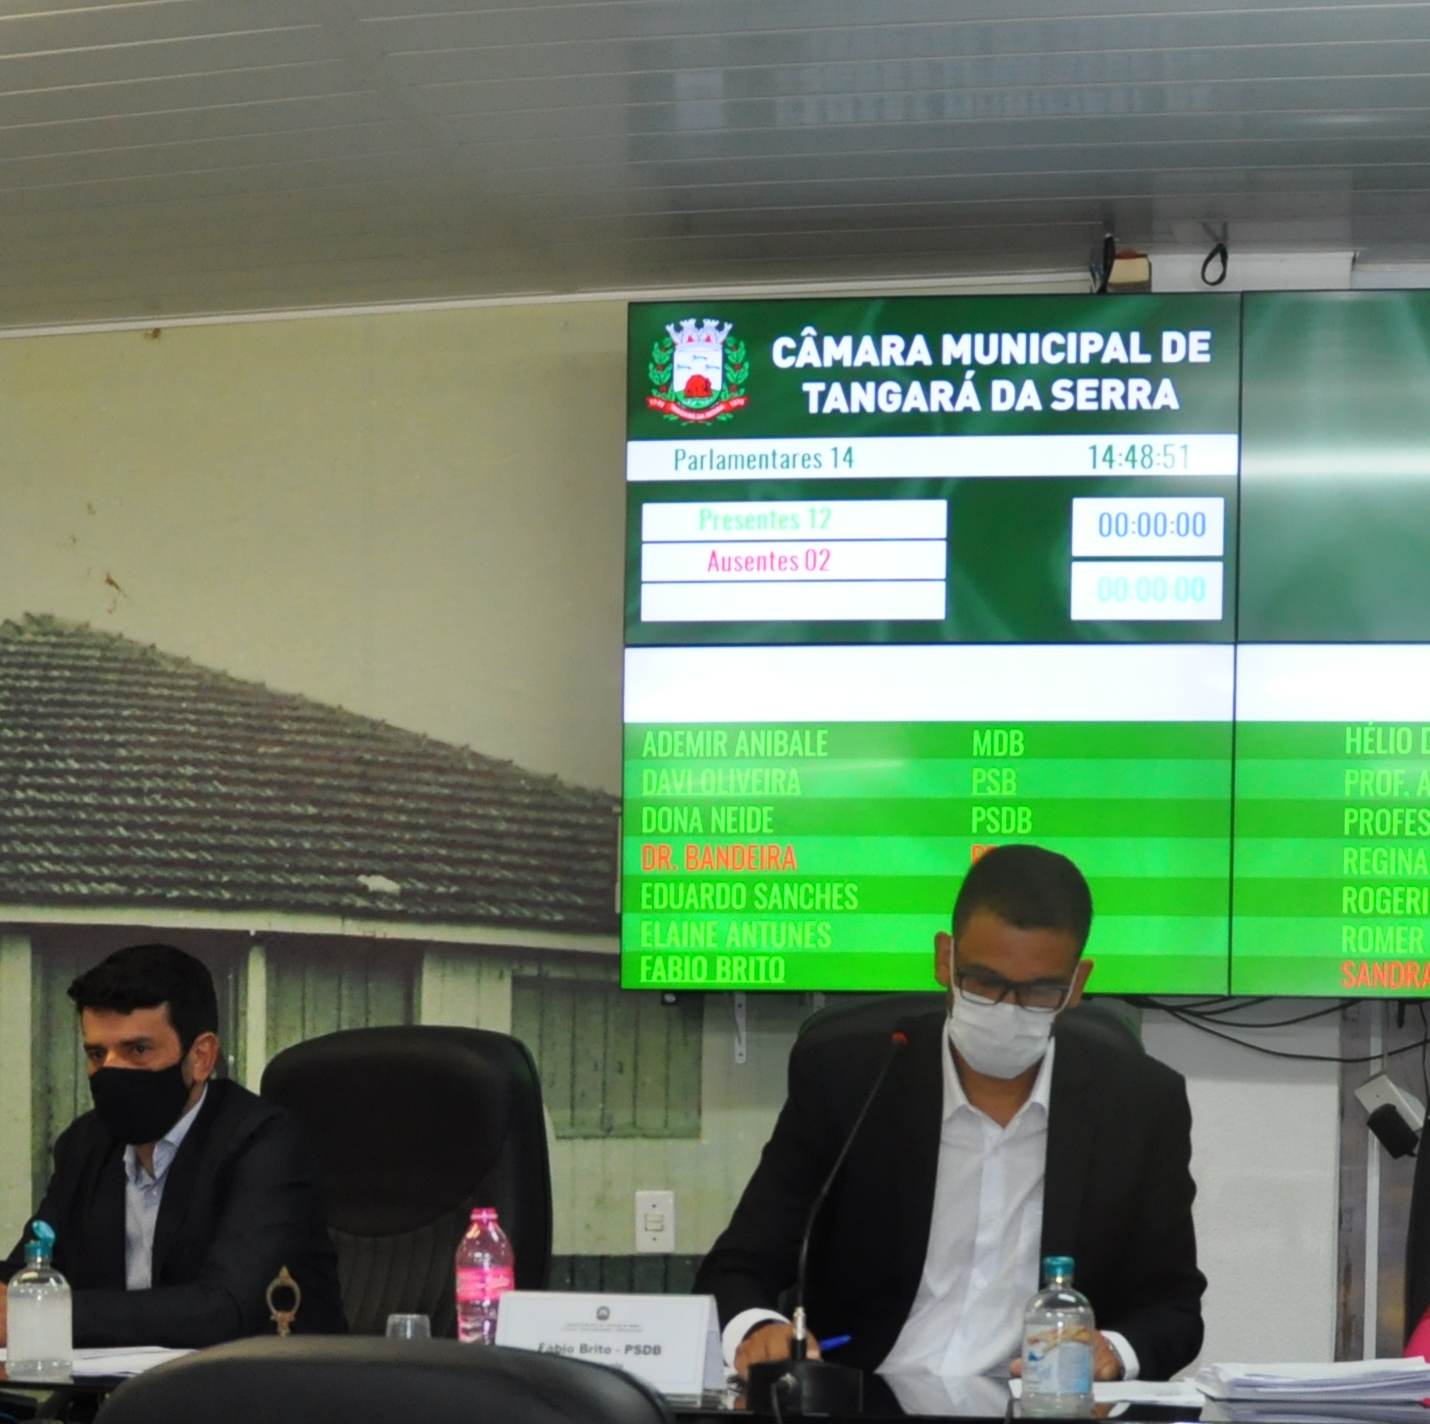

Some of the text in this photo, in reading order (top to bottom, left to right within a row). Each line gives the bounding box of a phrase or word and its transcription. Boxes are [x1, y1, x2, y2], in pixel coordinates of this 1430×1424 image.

[772, 326, 1212, 368] CÂMARA MUNICIPAL DE
[802, 370, 1180, 414] TANGARÁ DA SERRA
[673, 445, 855, 472] Parlamentares 14
[1087, 443, 1190, 470] 14:48:51
[699, 507, 833, 532] Presentes 12
[1098, 511, 1207, 539] 00:00:00
[707, 549, 832, 573] Ausentes 02
[1097, 576, 1207, 603] 00:00:00
[642, 729, 829, 758] ADEMIR ANIBALE
[973, 729, 1025, 757] MDB
[1345, 722, 1413, 755] HÉLIO
[641, 768, 802, 797] DAVI OLIVEIRA
[972, 768, 1017, 795] PSB
[1344, 770, 1407, 798] PROF.
[641, 806, 774, 834] DONA NEIDE
[972, 806, 1033, 834] PSDB
[641, 844, 797, 872] DR. BANDEIRA
[640, 882, 859, 911] EDUARDO SANCHES
[639, 921, 833, 949] ELAINE ANTUNES
[1341, 926, 1423, 955] ROMER
[639, 955, 786, 984] FABIO BRITO
[579, 1343, 612, 1355] Brito
[624, 1344, 662, 1356] PSDB
